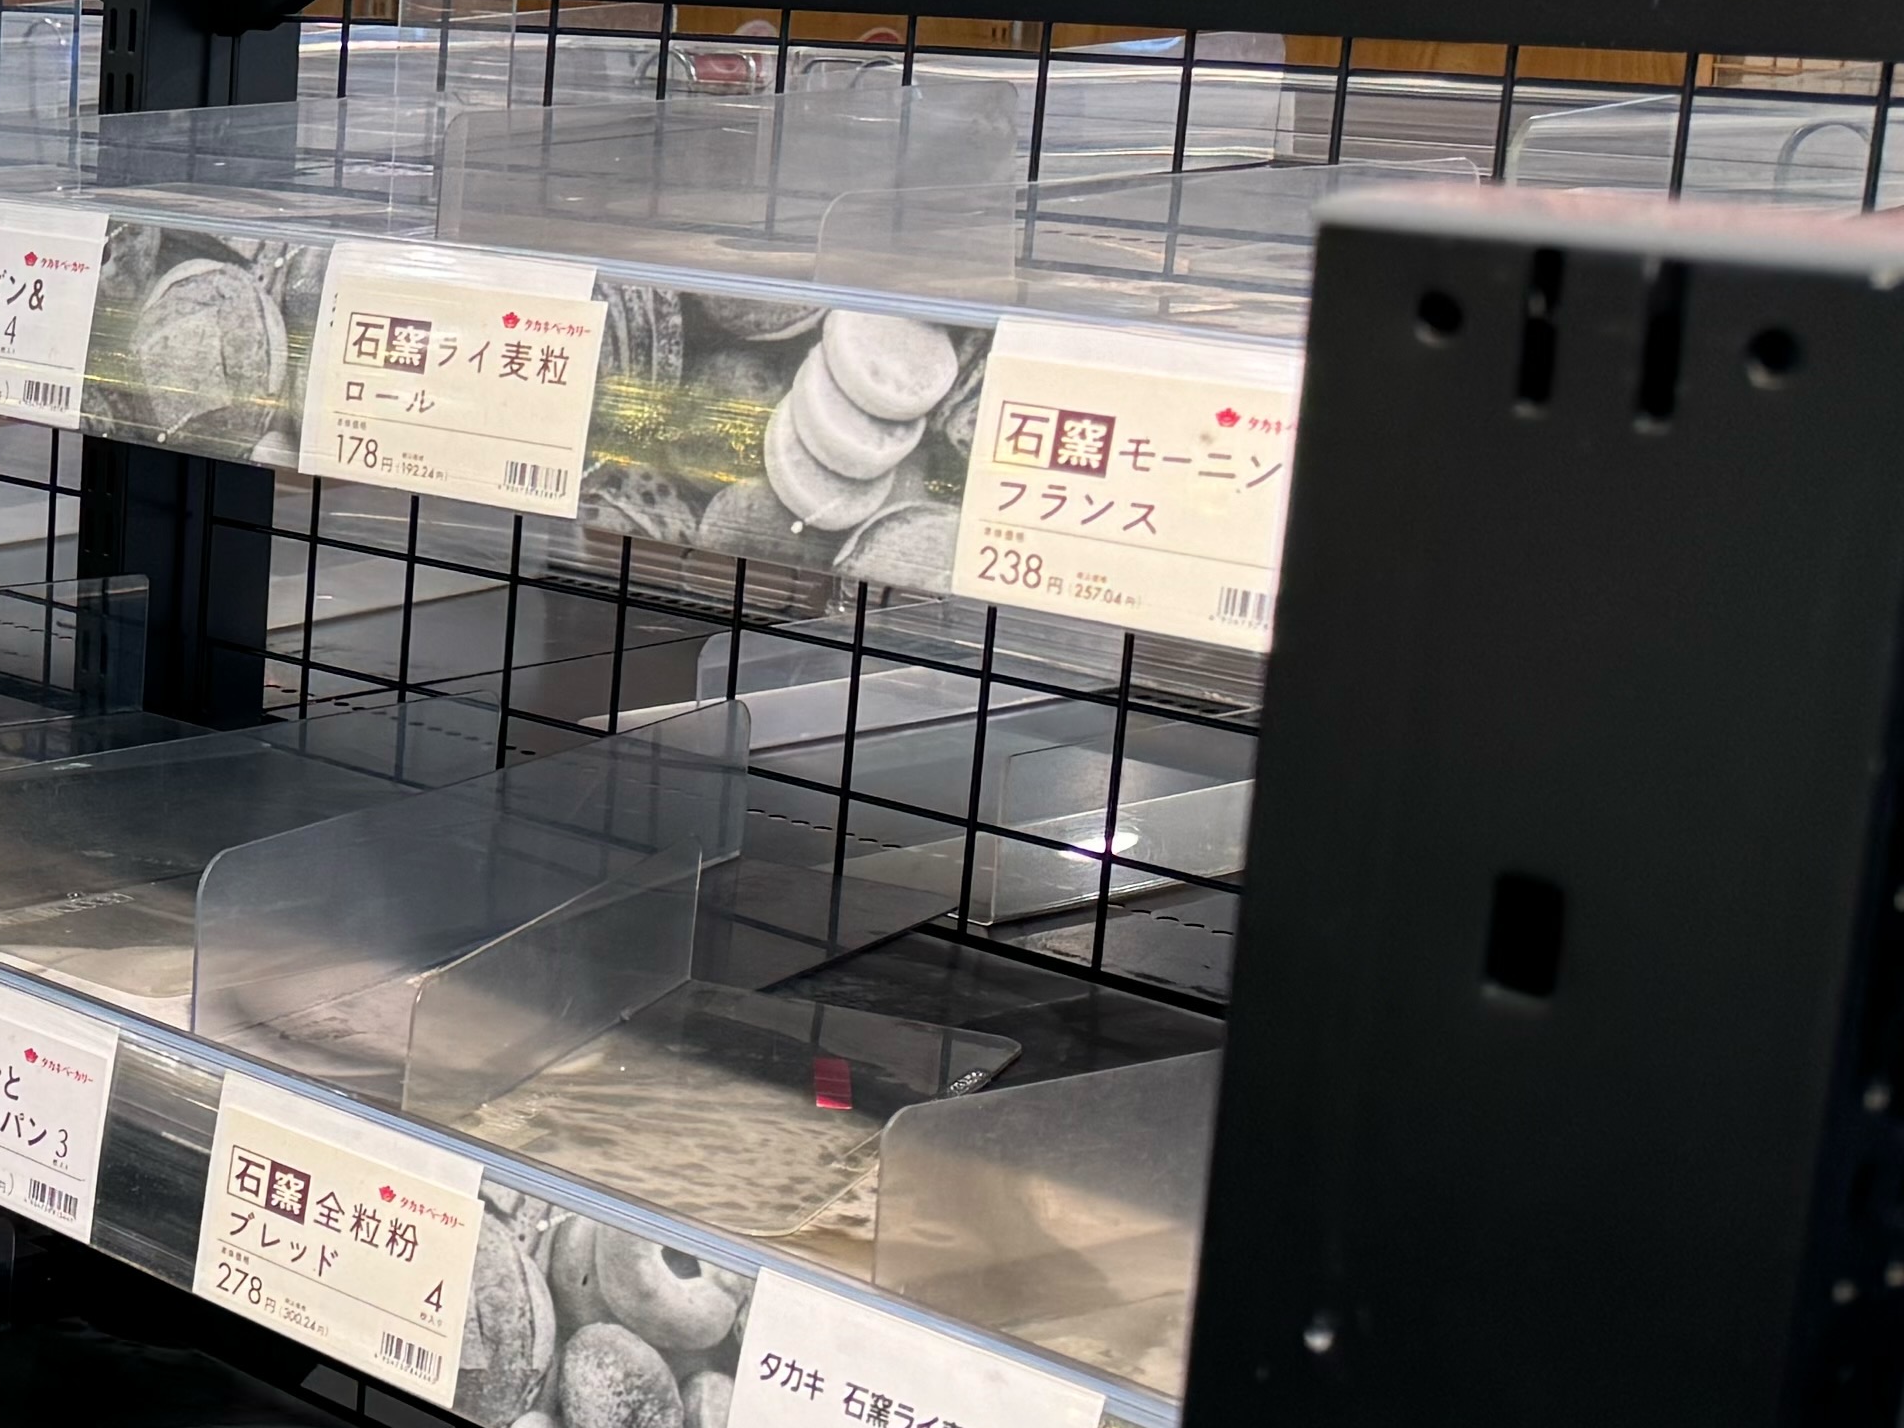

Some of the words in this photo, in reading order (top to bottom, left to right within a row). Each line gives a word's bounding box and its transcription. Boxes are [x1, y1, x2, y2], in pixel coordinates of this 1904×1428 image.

[4, 316, 18, 345] 4
[524, 318, 590, 337] タカキベーカリー
[351, 319, 570, 387] 石窯ライ麦粒
[345, 380, 435, 414] ロール
[337, 434, 392, 474] 178円
[998, 480, 1156, 535] フランス
[978, 546, 1063, 596] 238円
[41, 1057, 93, 1084] タカキベーカリー
[55, 1129, 68, 1159] 3
[235, 1155, 419, 1263] 石窯全粒粉
[400, 1196, 464, 1228] タカキベーカリー
[229, 1210, 339, 1277] ブレッド
[216, 1262, 276, 1314] 278円
[424, 1280, 443, 1313] 4
[759, 1351, 825, 1402] タカキ
